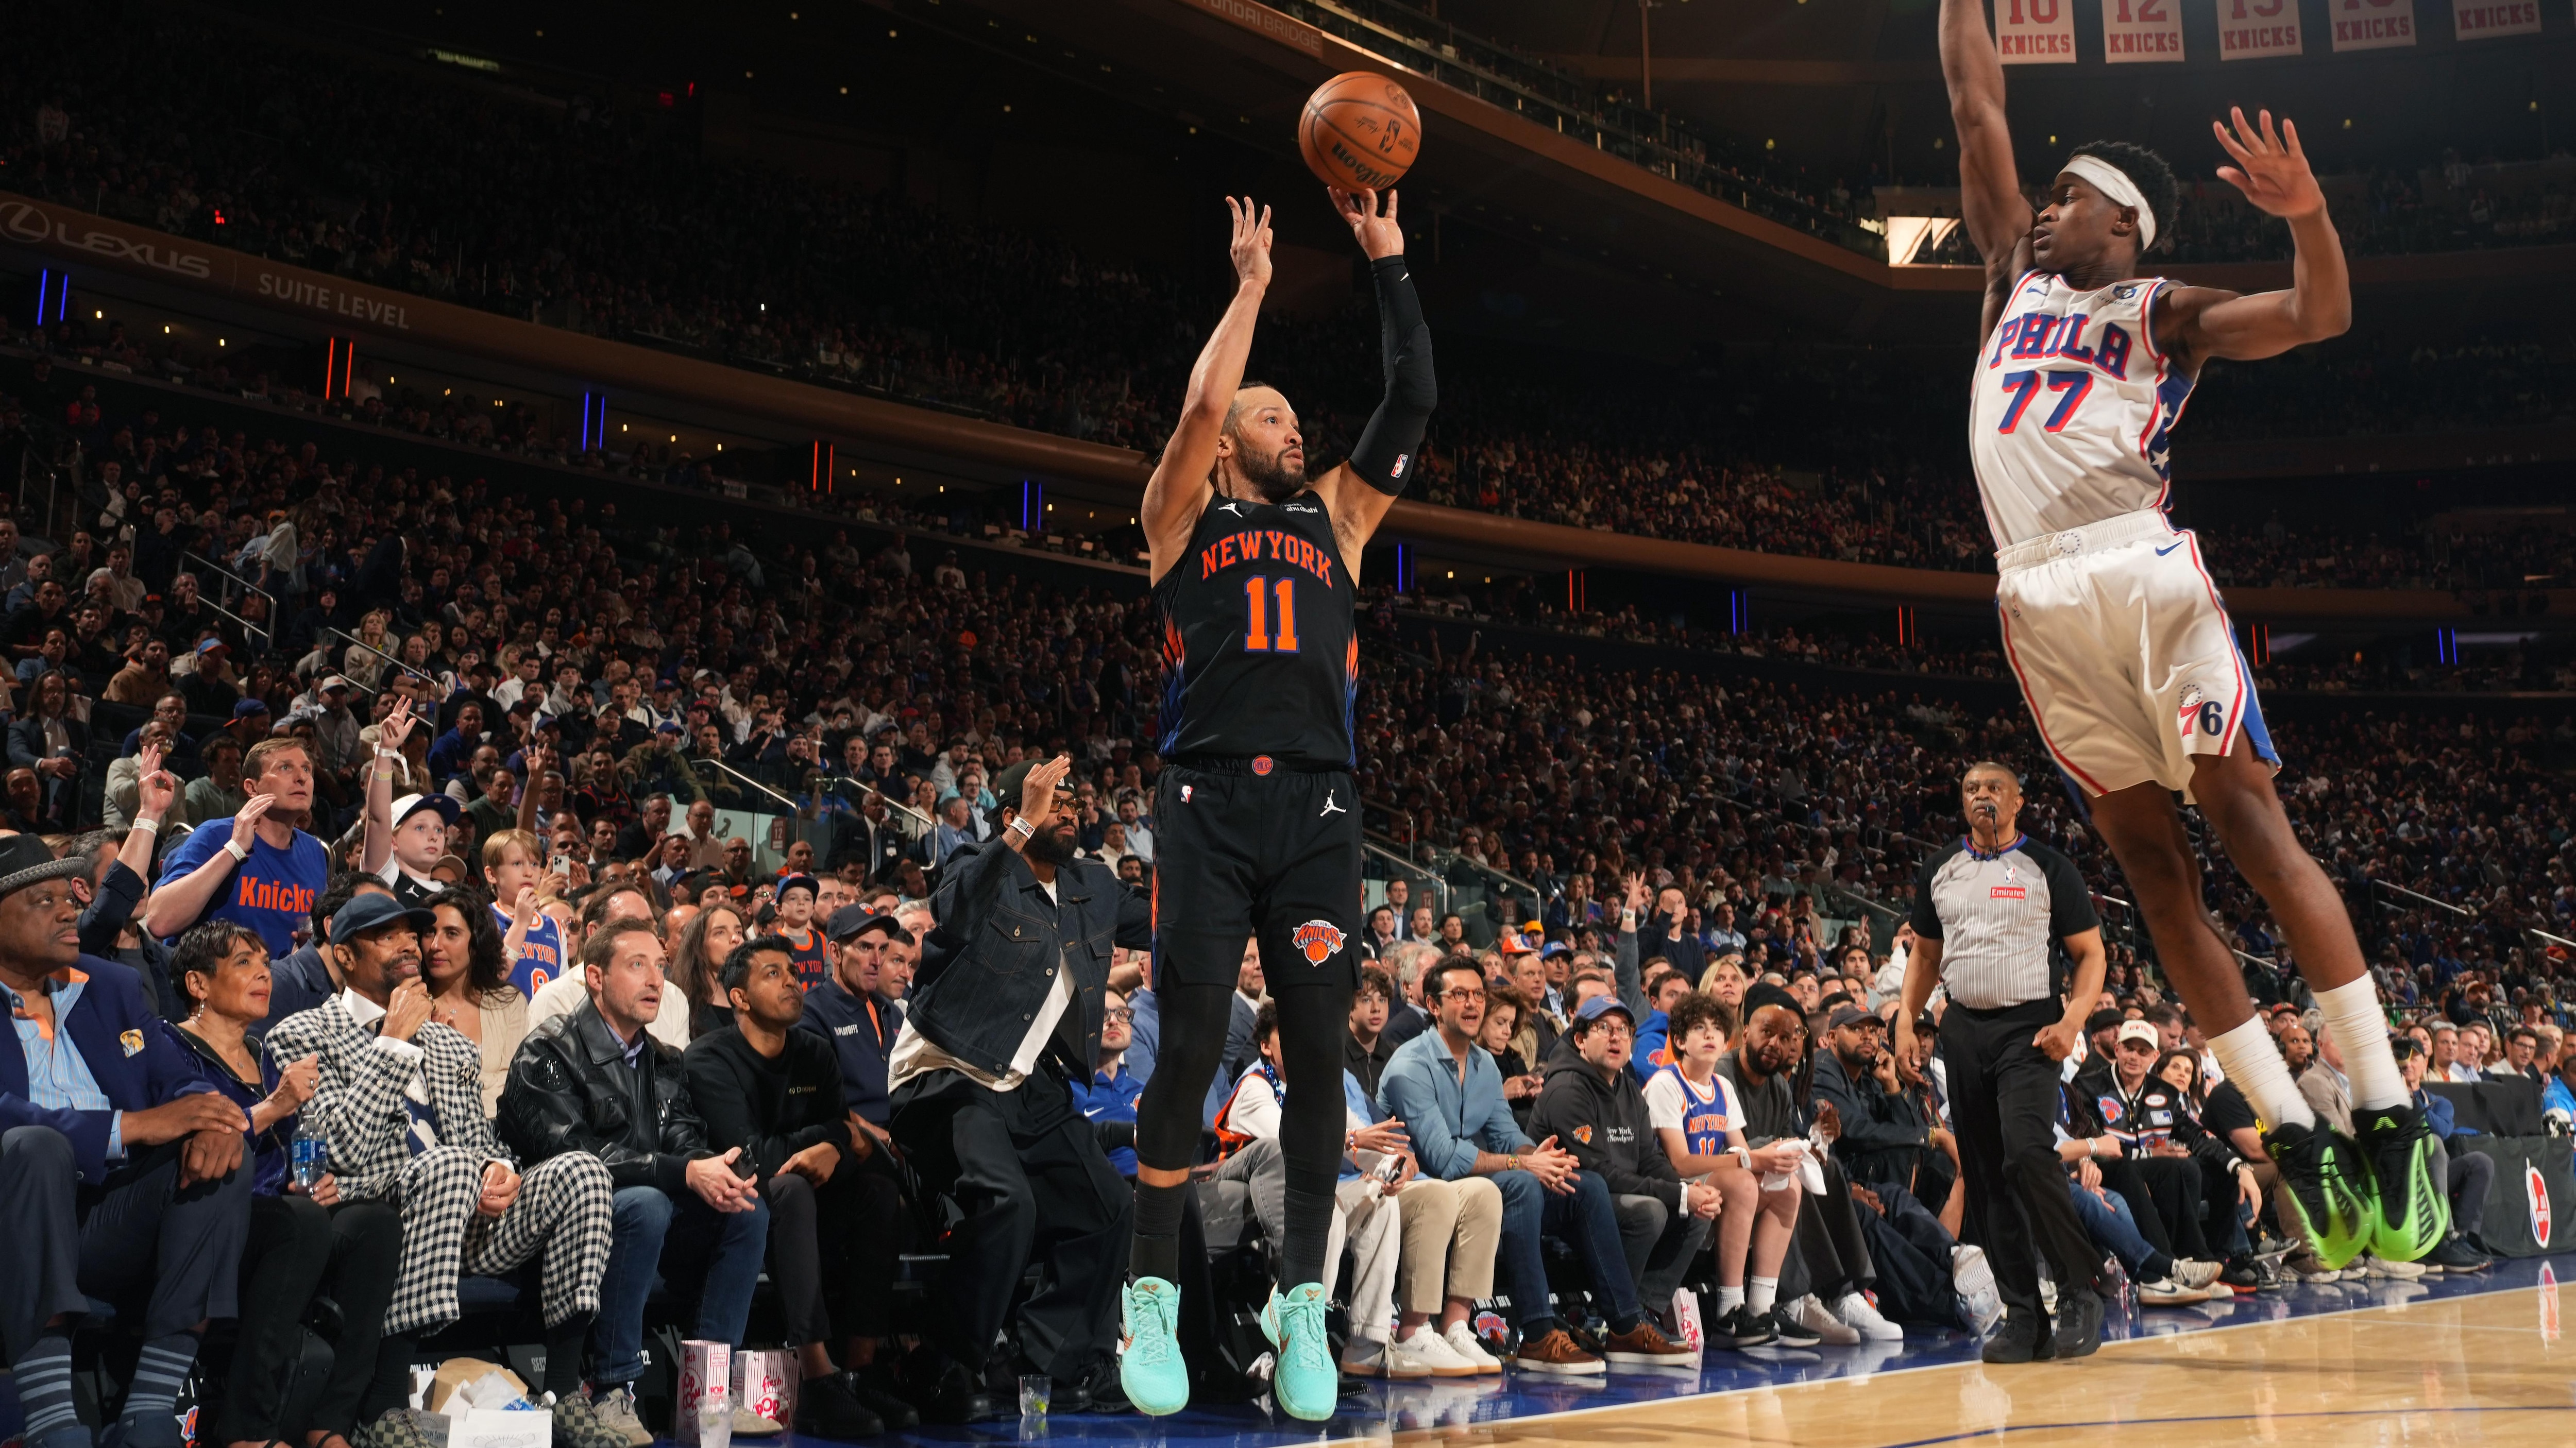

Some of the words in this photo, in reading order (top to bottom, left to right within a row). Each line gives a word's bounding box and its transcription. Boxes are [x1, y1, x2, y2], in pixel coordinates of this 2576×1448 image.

[2459, 2, 2535, 30] KNICKS
[1264, 15, 1320, 52] BRIDGE
[2224, 26, 2296, 50] KNICKS
[2336, 16, 2410, 41] KNICKS
[2001, 34, 2071, 55] KNICKS
[2109, 32, 2179, 54] KNICKS
[57, 223, 210, 279] LEXUS
[259, 272, 330, 310] SUITE
[338, 292, 410, 330] LEVEL
[1990, 313, 2132, 381] PHILA
[1998, 370, 2094, 434] 77
[1201, 531, 1263, 581] NEW
[1266, 531, 1333, 590] YORK
[1244, 574, 1300, 654] 11
[2179, 701, 2223, 737] 76
[1255, 760, 1271, 771] KNICKS
[774, 828, 783, 840] 12
[239, 876, 315, 913] Knicks
[1992, 888, 2024, 898] Emirates
[1296, 925, 1342, 948] KNICKS
[839, 1024, 858, 1036] PLAYOFFS
[2141, 1025, 2151, 1036] YORK
[802, 1085, 817, 1093] Doppel
[1688, 1116, 1706, 1134] NEW
[531, 1356, 547, 1372] SECT
[762, 1375, 782, 1393] fresh
[421, 1427, 434, 1441] SQUARE
[434, 1429, 448, 1442] GARDEN
